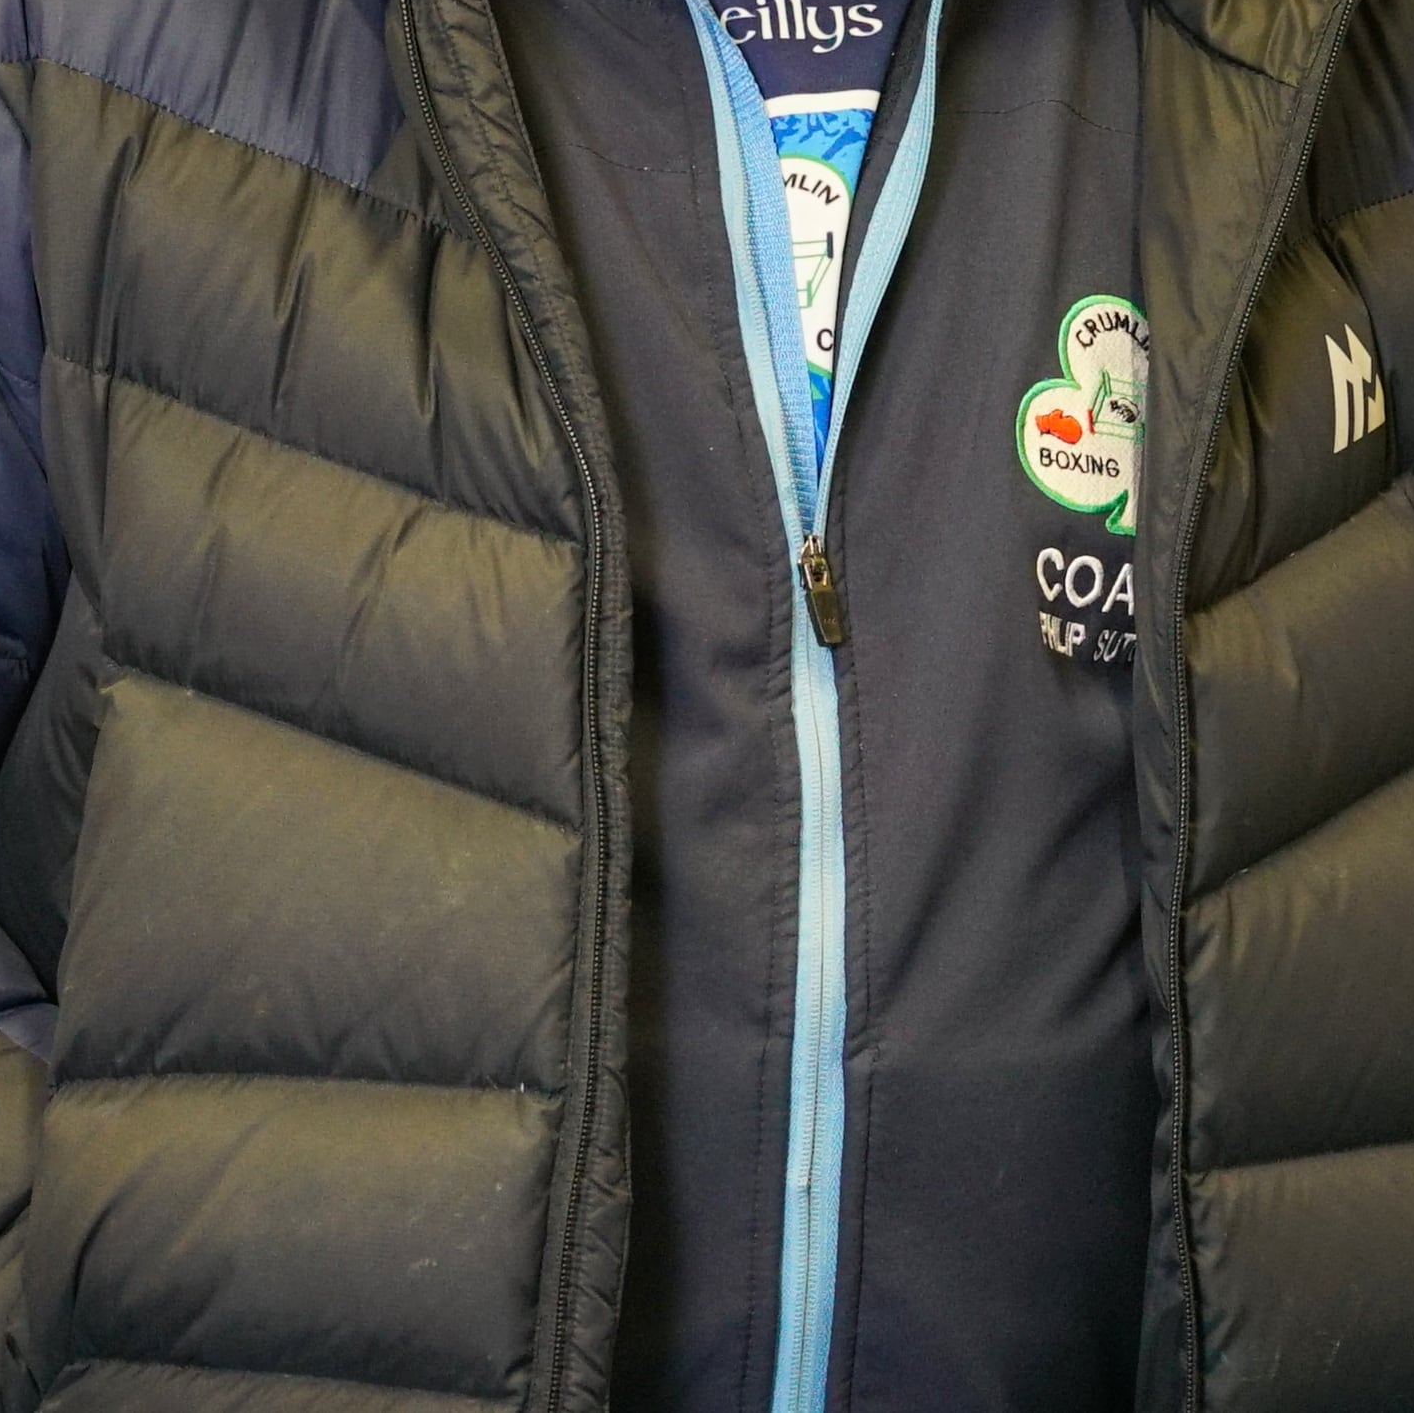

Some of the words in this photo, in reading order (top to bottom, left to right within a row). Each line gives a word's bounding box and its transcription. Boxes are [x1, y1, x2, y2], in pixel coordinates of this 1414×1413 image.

[1075, 311, 1149, 352] CRUMLI
[1039, 447, 1120, 478] BOXING
[1036, 547, 1135, 617] COA
